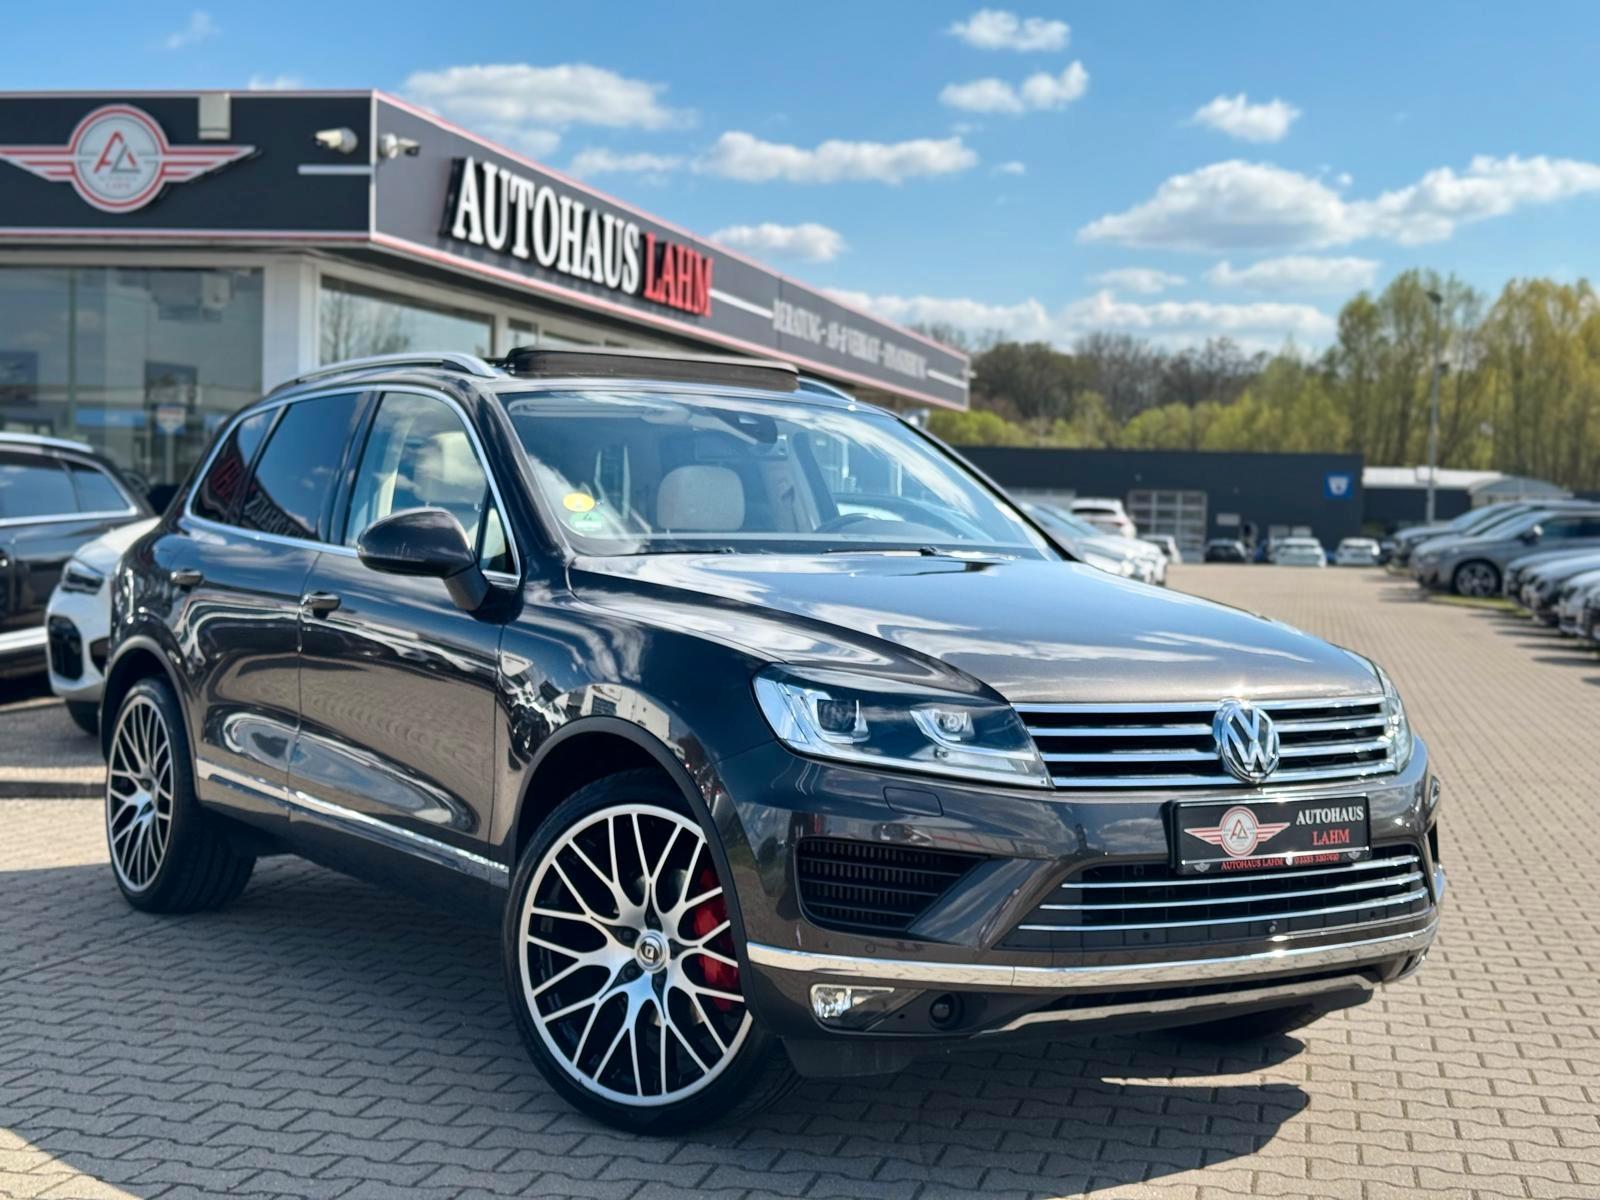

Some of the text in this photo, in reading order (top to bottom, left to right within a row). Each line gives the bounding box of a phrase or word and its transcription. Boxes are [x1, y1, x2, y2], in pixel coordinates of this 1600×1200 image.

[452, 156, 713, 317] AUTOHAUS LAHM
[1296, 805, 1364, 825] AUTOHAUS
[1312, 829, 1350, 846] LAHM
[1221, 860, 1261, 870] AUTOHAUS
[1262, 858, 1284, 867] LAHM
